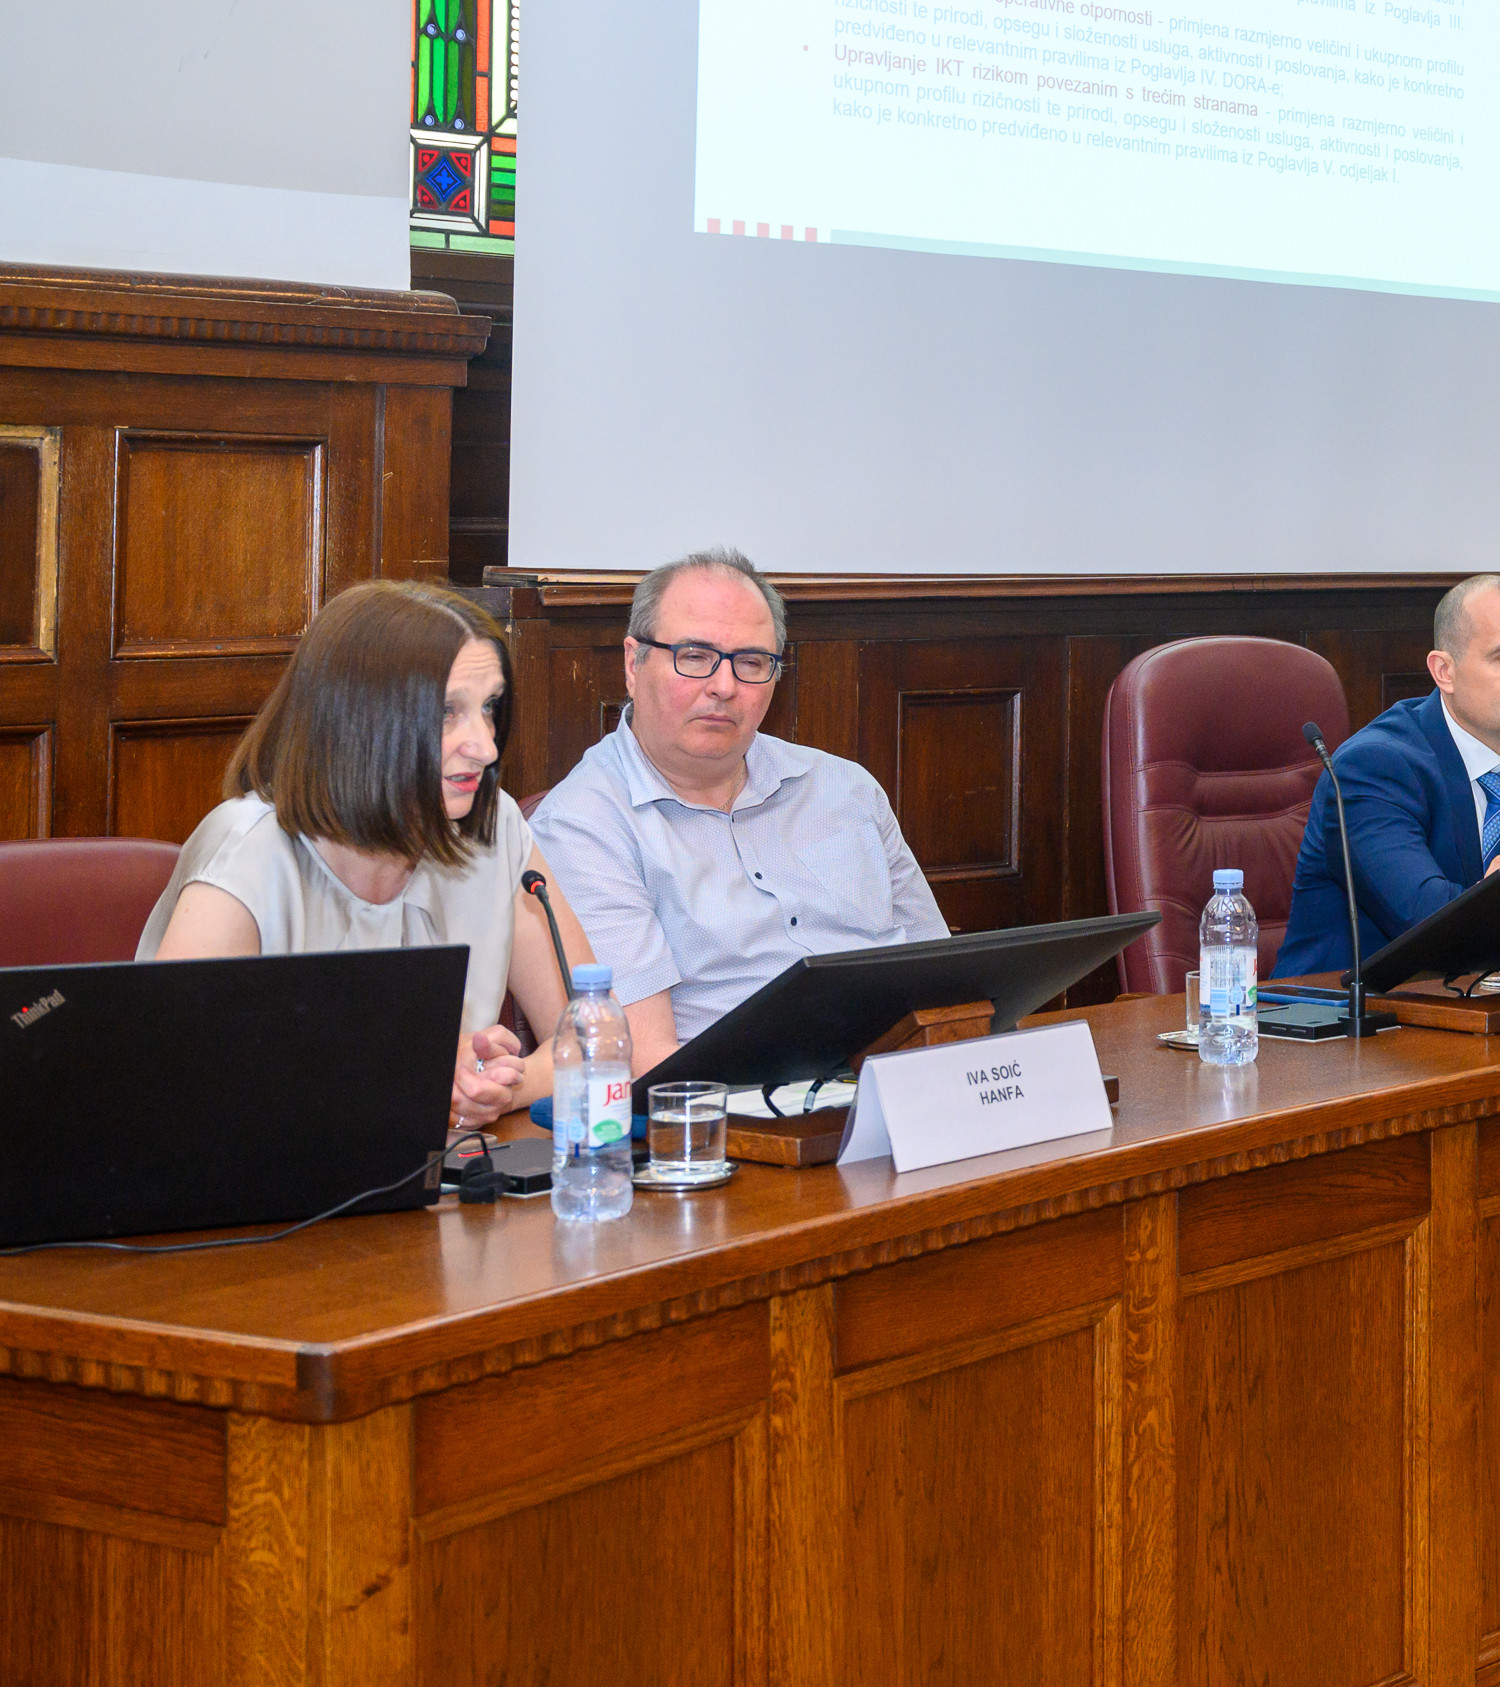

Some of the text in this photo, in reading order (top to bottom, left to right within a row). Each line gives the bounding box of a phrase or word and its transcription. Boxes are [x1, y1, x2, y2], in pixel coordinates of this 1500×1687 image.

[913, 3, 927, 18] te
[933, 7, 987, 29] prirodi,
[993, 15, 1050, 39] opsegu
[1056, 21, 1059, 38] i
[1064, 24, 1137, 49] složenosti
[1143, 38, 1193, 60] usluga,
[1199, 46, 1263, 69] aktivnosti
[1267, 53, 1270, 69] i
[1275, 58, 1349, 84] poslovanja,
[1354, 68, 1384, 87] kako
[1388, 77, 1399, 92] je
[1404, 76, 1464, 99] konkretno
[1081, 2, 1152, 27] otpornosti
[1169, 16, 1228, 39] primjena
[1235, 27, 1301, 50] razmjerno
[1307, 38, 1351, 58] veličini
[1356, 44, 1359, 59] i
[1364, 48, 1421, 68] ukupnom
[1427, 58, 1464, 76] profilu
[1365, 1, 1375, 14] iz
[1385, 2, 1440, 29] Poglavlja
[1450, 14, 1464, 30] III.
[835, 19, 1284, 98] predviđeno u relevantnim pravilima iz Poglavlja IV. DORA-e;
[835, 43, 927, 75] Upravljanje
[936, 57, 964, 77] IKT
[973, 64, 1028, 85] rizikom
[1038, 74, 1117, 98] povezanim
[1126, 87, 1134, 100] s
[1143, 86, 1186, 107] trećim
[1194, 95, 1258, 117] stranama
[1278, 107, 1335, 128] primjena
[1342, 116, 1405, 137] razmjerno
[1412, 126, 1453, 144] veličini
[1460, 132, 1463, 146] i
[833, 98, 1400, 184] kako je konkretno predviđeno u relevantnim pravilima iz Poglavlja V. odjeljak I.
[834, 72, 1463, 171] ukupnom profilu rizičnosti te prirodi, opsegu i složenosti usluga, aktivnosti i poslovanja,
[10, 988, 65, 1029] ThinkPad
[966, 1060, 1022, 1086] IVA SOIĆ
[980, 1085, 1024, 1105] HANFA
